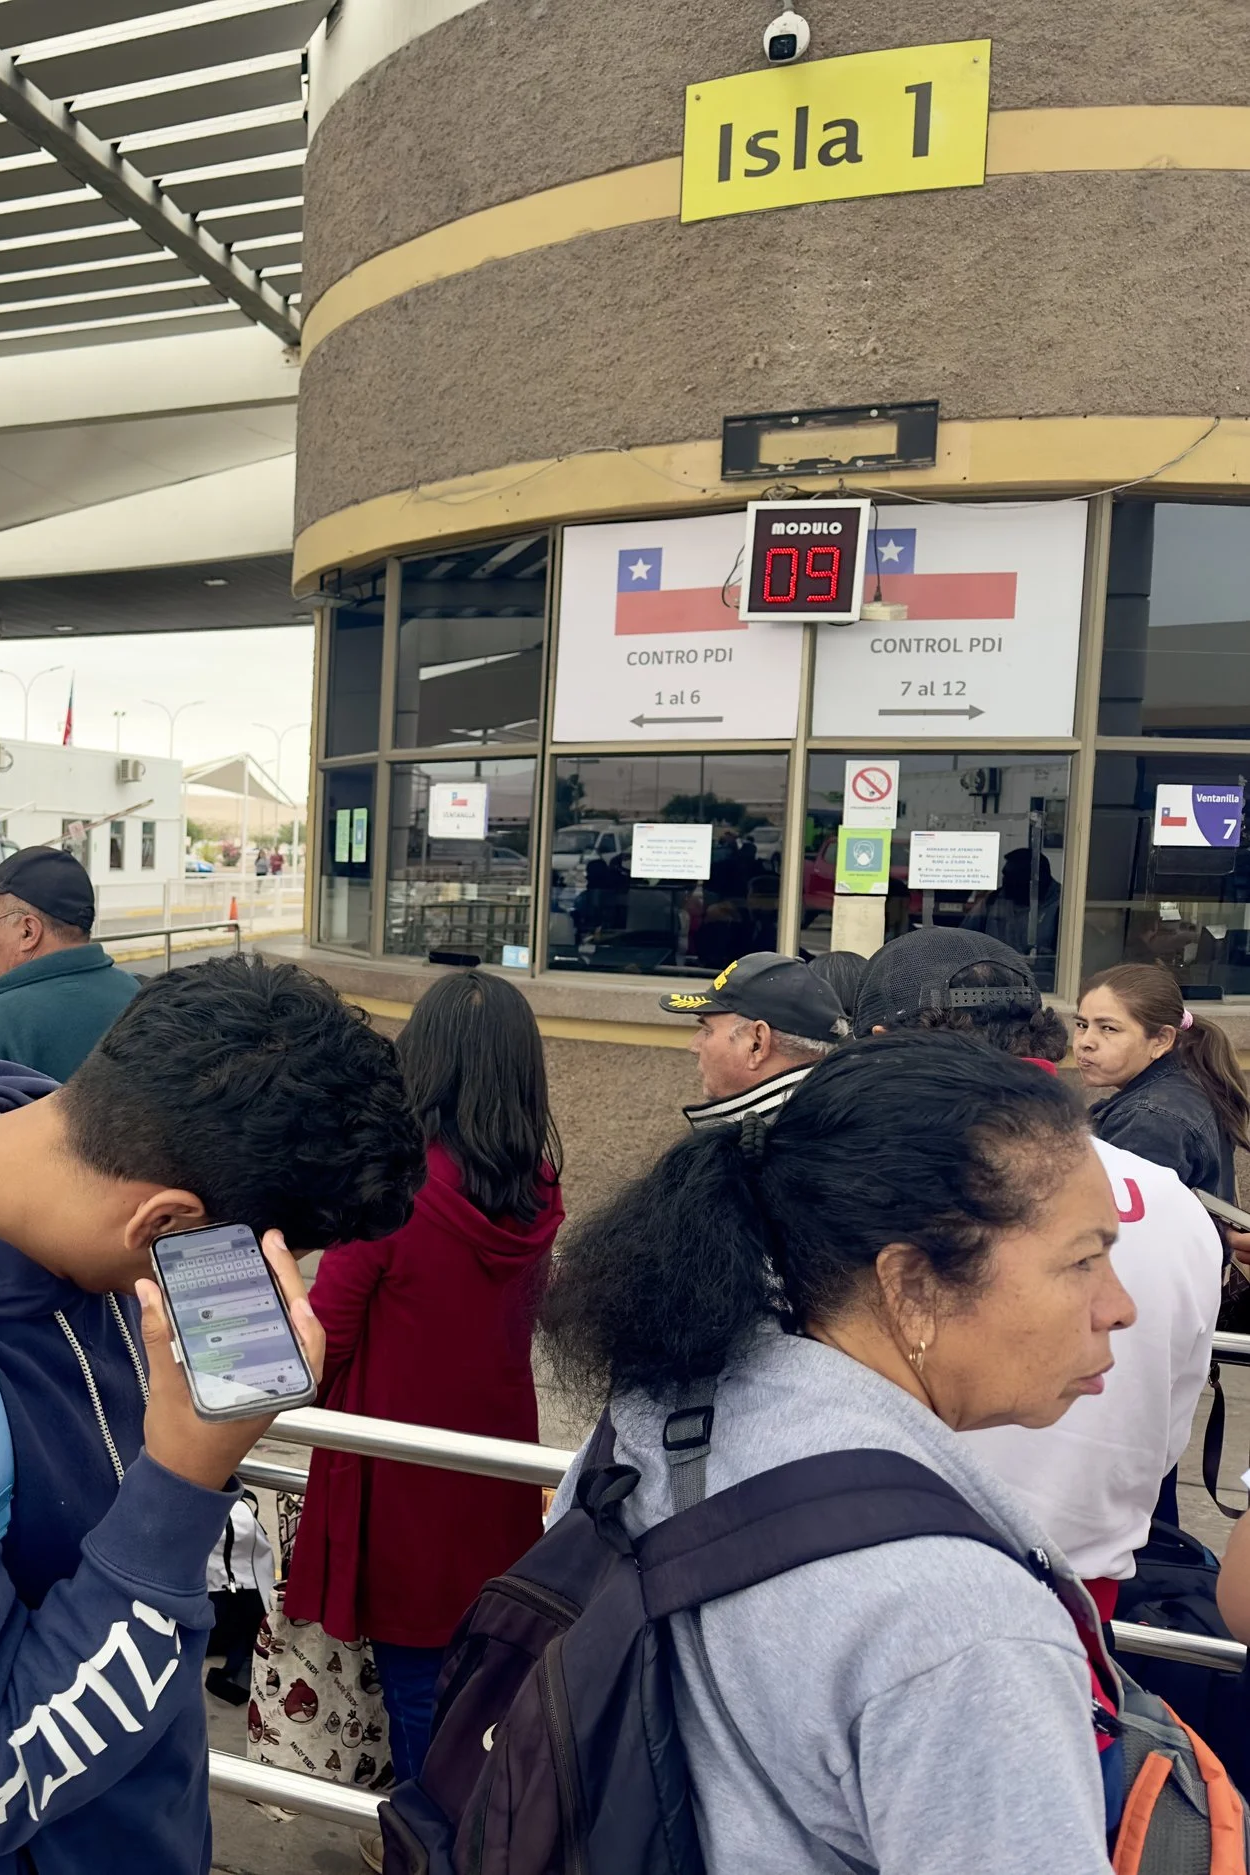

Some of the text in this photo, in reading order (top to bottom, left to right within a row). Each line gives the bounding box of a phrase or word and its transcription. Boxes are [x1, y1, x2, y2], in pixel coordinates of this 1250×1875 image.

[717, 81, 933, 183] Isla 1
[771, 521, 843, 535] MODULO
[763, 547, 840, 603] 09
[869, 636, 1003, 655] CONTROL PDI
[626, 647, 734, 667] CONTRO PDI
[654, 690, 701, 706] 1 al 6
[900, 680, 967, 697] 7 al 12
[1196, 793, 1240, 803] Ventanilla
[1223, 819, 1237, 840] 7
